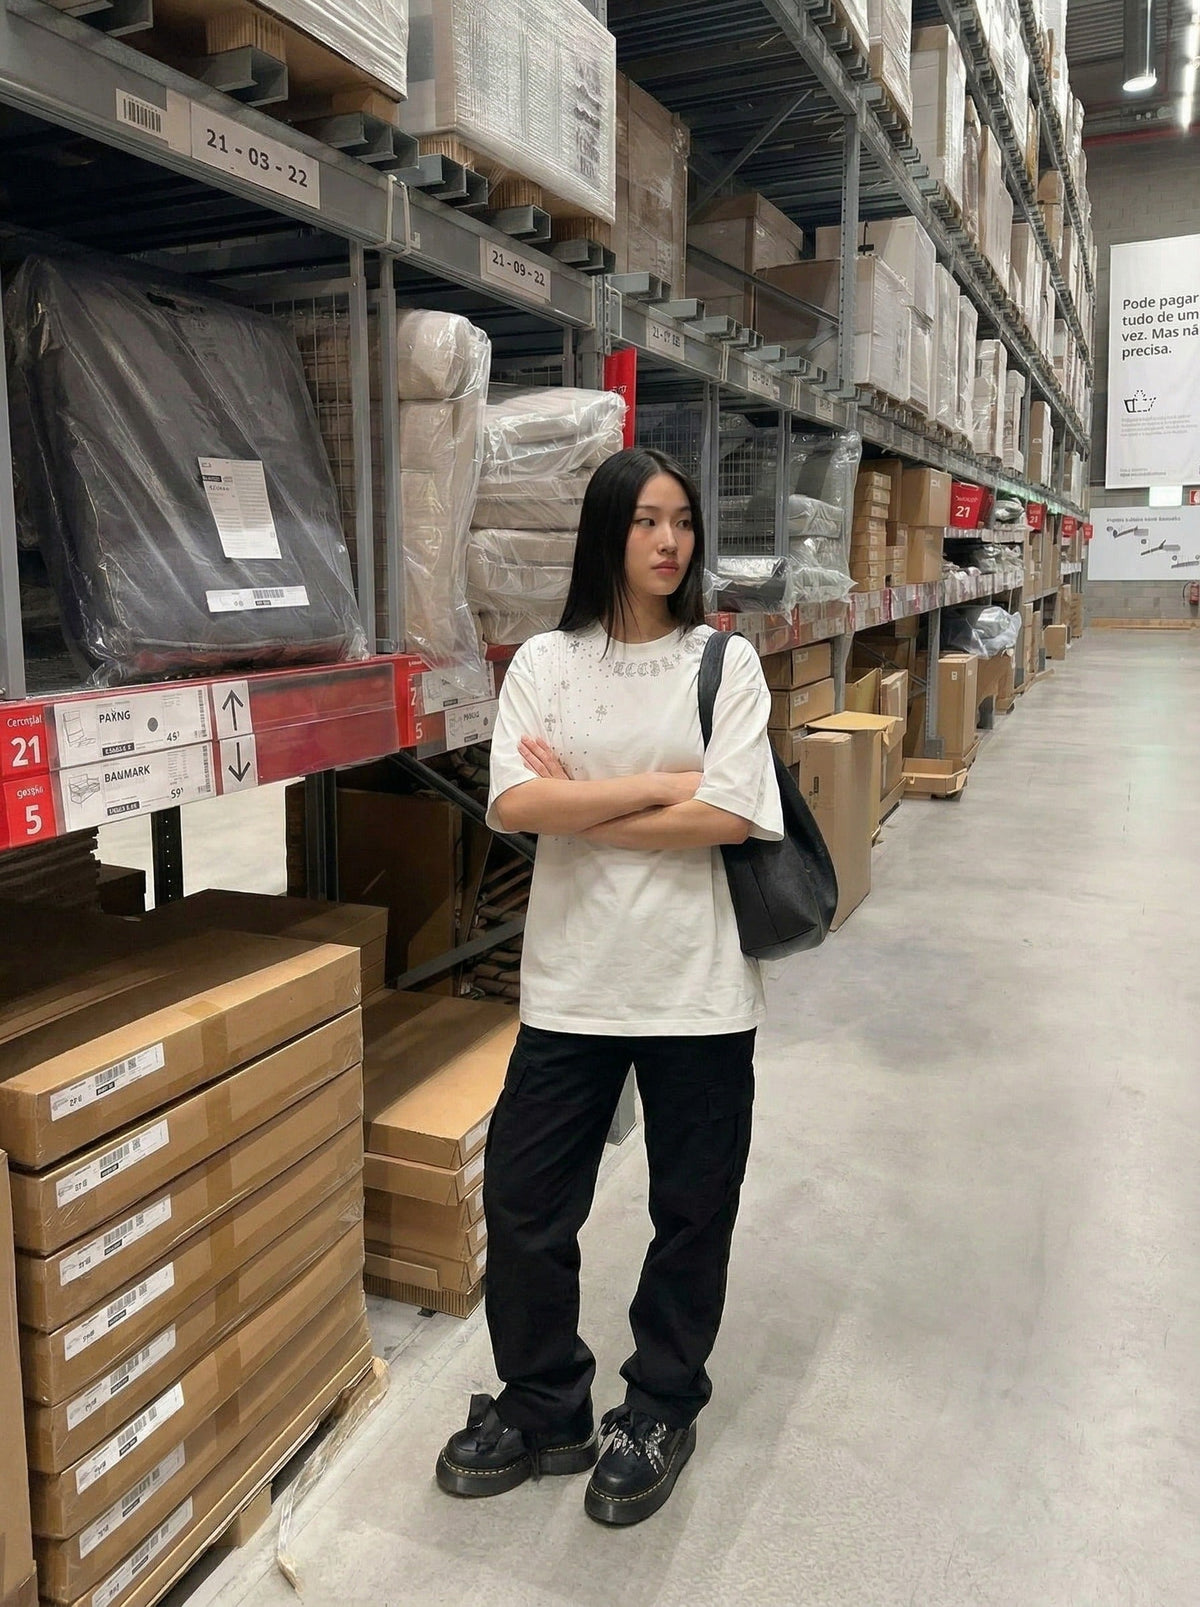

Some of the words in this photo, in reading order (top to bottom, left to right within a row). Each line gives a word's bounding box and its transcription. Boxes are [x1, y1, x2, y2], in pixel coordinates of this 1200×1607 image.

[1123, 296, 1156, 311] Pode
[1159, 294, 1200, 310] pagar
[1122, 312, 1154, 326] tudo
[1157, 311, 1174, 323] de
[1121, 331, 1148, 342] vez.
[1151, 327, 1179, 340] Mas
[1122, 343, 1172, 361] precisa.
[954, 505, 971, 518] 21
[10, 735, 41, 768] 21
[24, 803, 43, 836] 5
